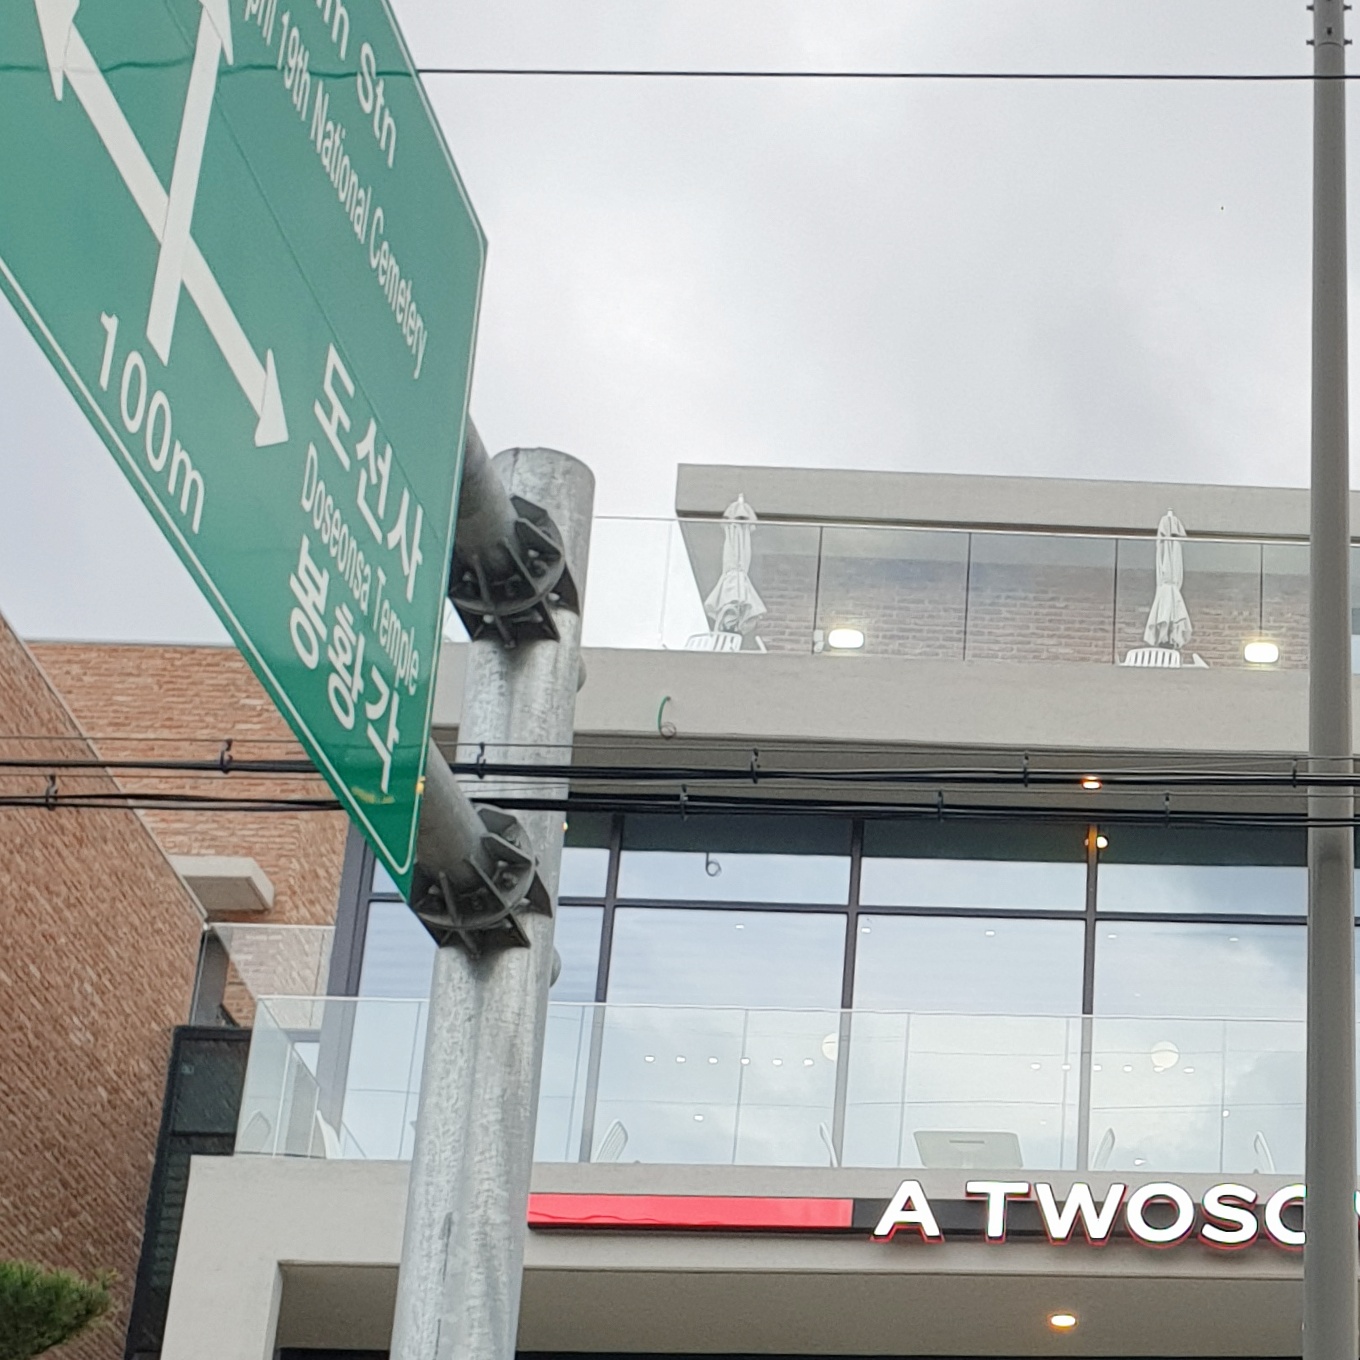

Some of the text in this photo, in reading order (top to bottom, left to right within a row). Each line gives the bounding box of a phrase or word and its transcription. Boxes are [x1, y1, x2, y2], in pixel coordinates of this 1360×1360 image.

[277, 11, 311, 121] 19th
[310, 79, 371, 244] National
[369, 207, 428, 379] Cemetery
[357, 42, 397, 169] Stn
[99, 310, 205, 535] 100m
[314, 343, 423, 603] 도선사
[289, 534, 400, 794] 봉황각
[301, 441, 420, 696] Doseonsa Temple
[871, 1179, 943, 1242] A
